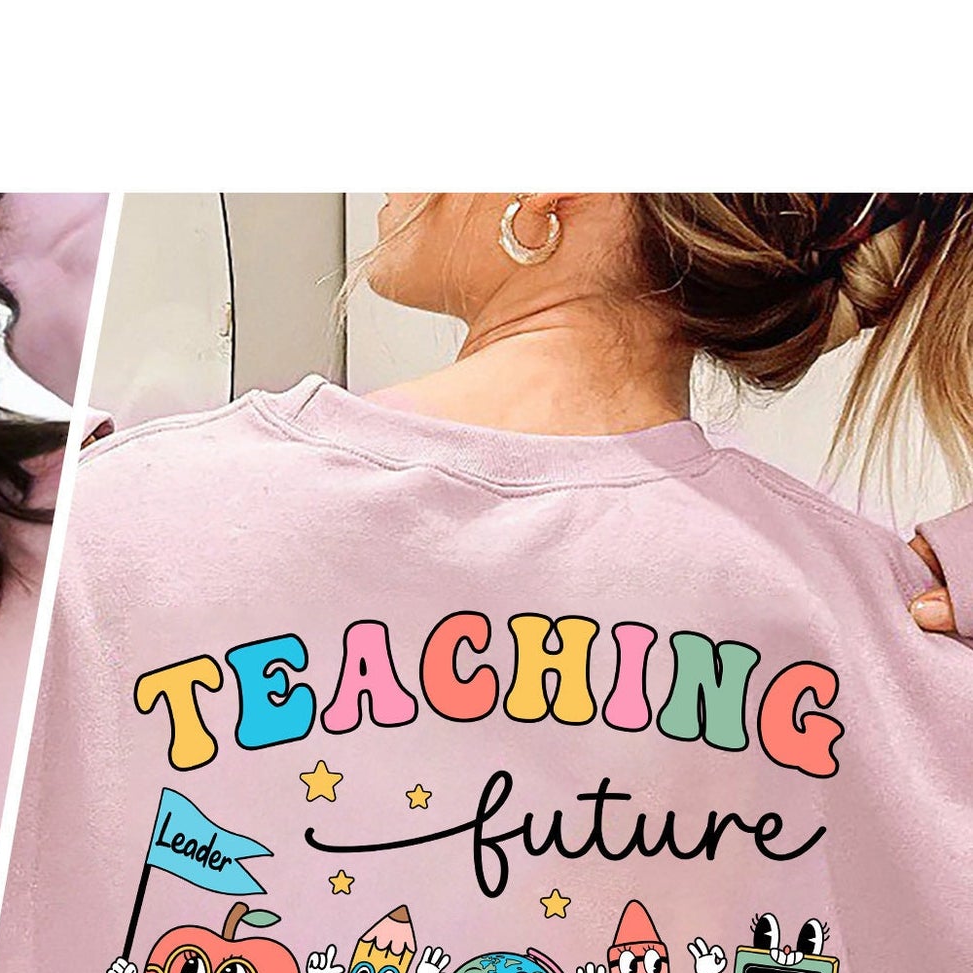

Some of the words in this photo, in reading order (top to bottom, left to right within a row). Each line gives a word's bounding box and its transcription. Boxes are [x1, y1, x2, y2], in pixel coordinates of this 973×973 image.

[135, 610, 845, 779] TEACHING
[155, 811, 234, 873] Leader
[305, 770, 827, 898] future
